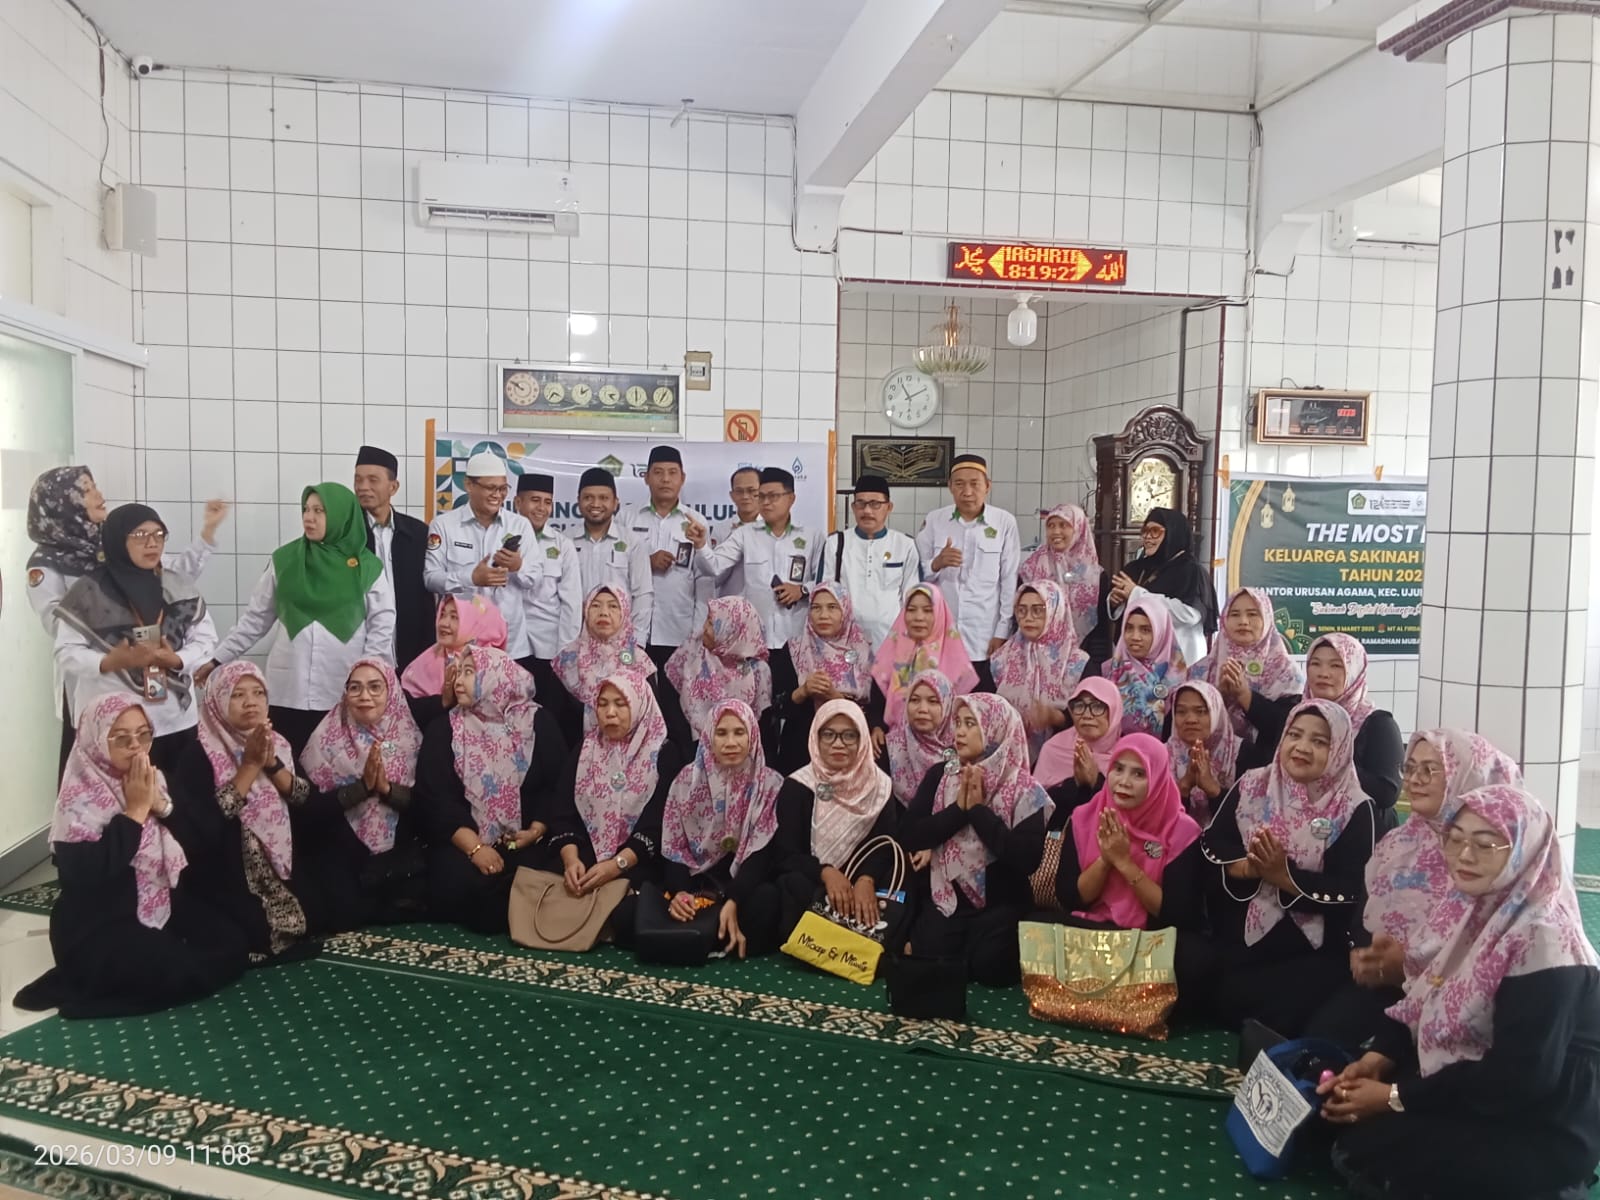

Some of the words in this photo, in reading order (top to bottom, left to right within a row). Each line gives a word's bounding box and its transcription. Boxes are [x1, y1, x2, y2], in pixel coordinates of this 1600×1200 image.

[1307, 523, 1350, 543] THE
[1351, 524, 1418, 544] MOST
[1264, 549, 1347, 563] KELUARGA
[1349, 551, 1419, 564] SAKINAH
[1339, 568, 1393, 582] TAHUN
[1295, 587, 1336, 597] URUSAN
[1336, 588, 1377, 599] AGAMA,
[1378, 588, 1400, 598] KEC.
[828, 947, 838, 960] &
